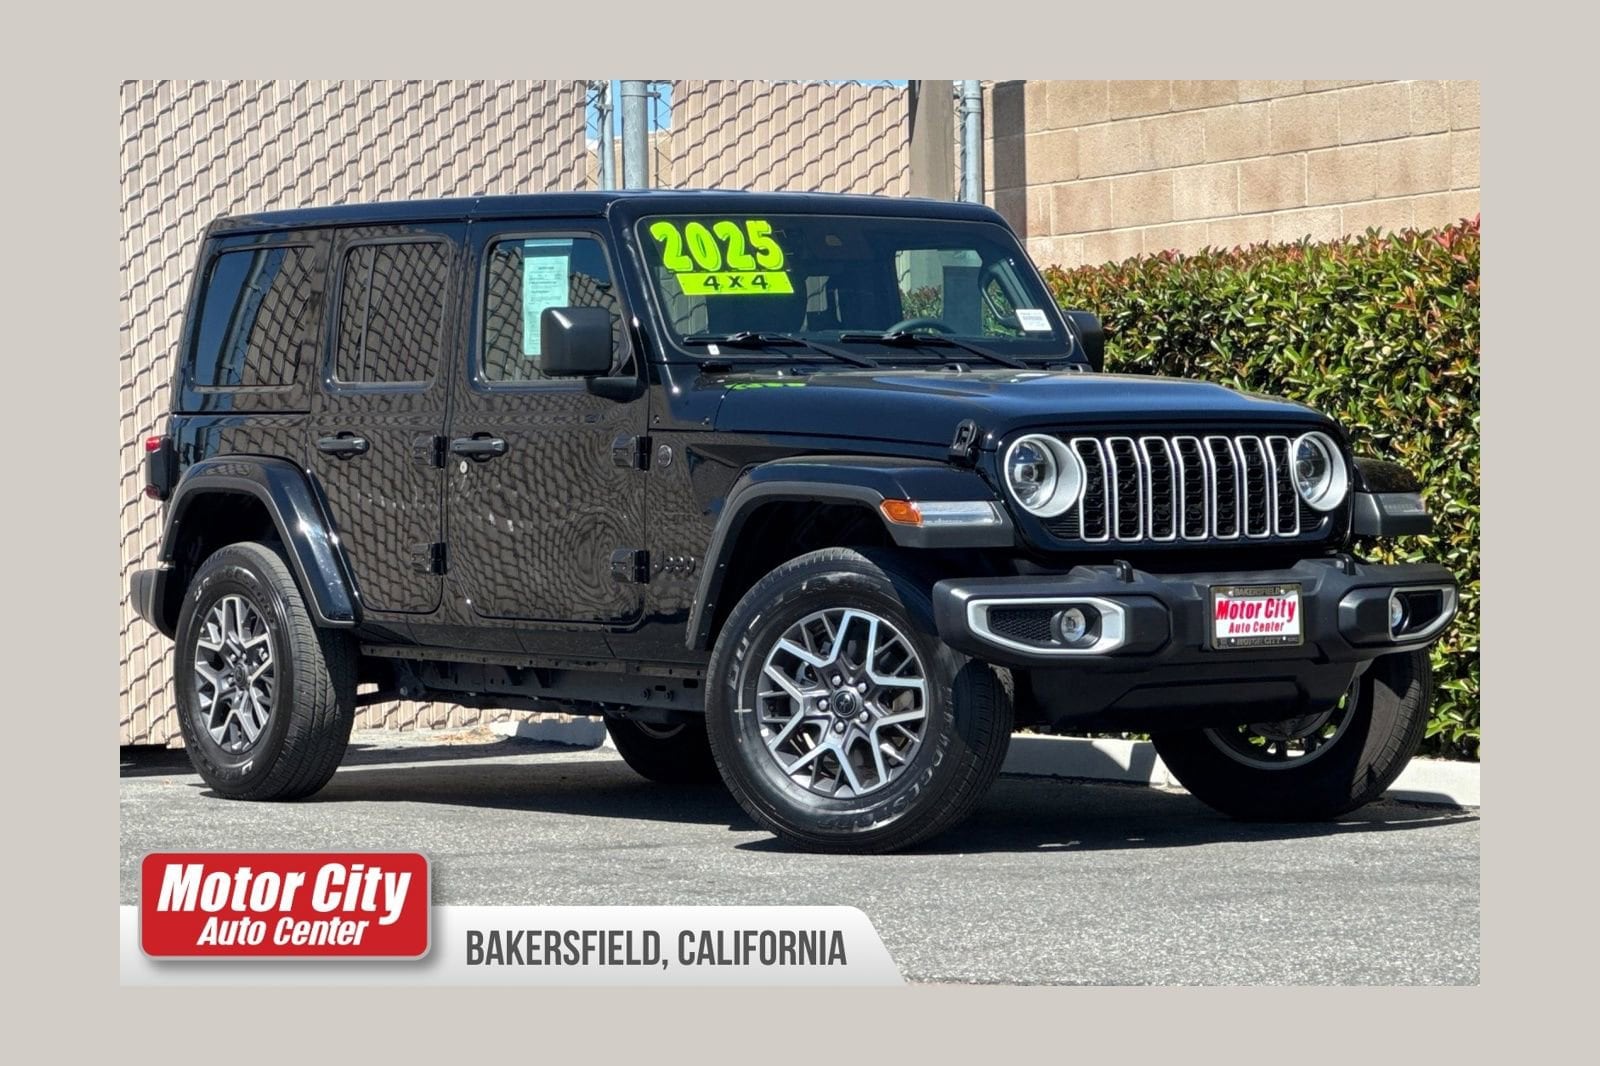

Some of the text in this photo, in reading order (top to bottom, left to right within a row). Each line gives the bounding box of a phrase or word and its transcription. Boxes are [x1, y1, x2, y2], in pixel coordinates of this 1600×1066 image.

[650, 220, 784, 271] 2025
[1216, 598, 1297, 623] Motor City
[1228, 621, 1284, 634] Auto Center
